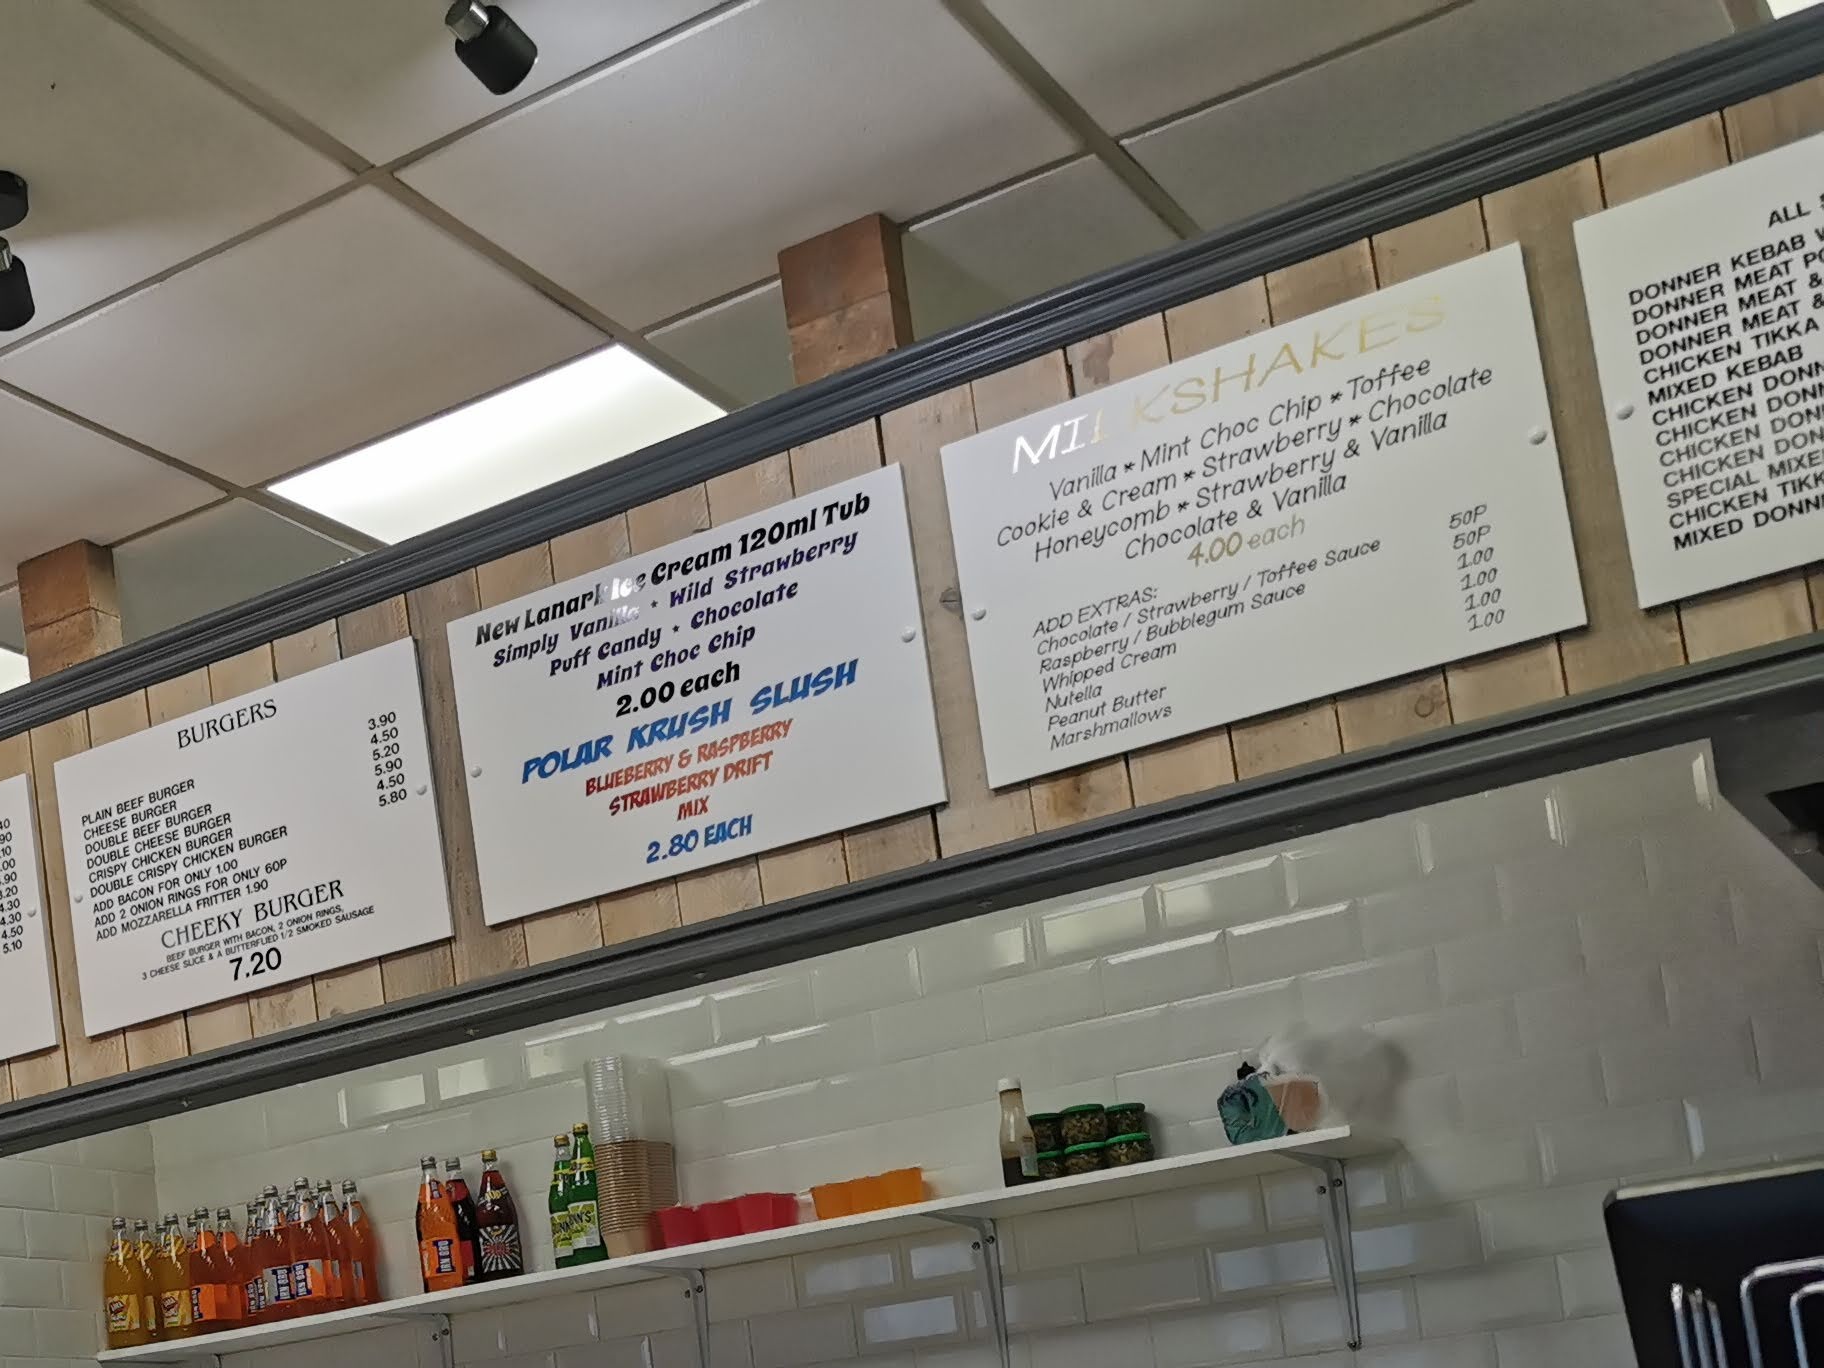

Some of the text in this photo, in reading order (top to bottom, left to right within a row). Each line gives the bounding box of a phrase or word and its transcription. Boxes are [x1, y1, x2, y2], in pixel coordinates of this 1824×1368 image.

[1768, 202, 1811, 228] ALL
[1628, 234, 1806, 306] DONNER KEBAB
[1632, 259, 1792, 326] DONNER MEAT
[1635, 272, 1823, 346] DONNER MEAT &
[1639, 292, 1824, 366] DONNER MEAT &
[1643, 317, 1820, 385] CHICKEN TIKKA
[1647, 344, 1804, 406] MIXED KEBAB
[997, 367, 1493, 547] Cookie & Cream Strawberry Chocolate
[1049, 359, 1431, 501] Vanilla Mint Choc Chip Toffee
[1035, 411, 1448, 563] Honeycomb Strawberry & Vanilla
[1125, 473, 1347, 560] Chocolate & Vanilla
[1186, 514, 1305, 568] 4.00 each
[1448, 504, 1487, 530] 50P
[475, 616, 521, 647] New
[650, 542, 732, 586] Cream
[738, 508, 818, 556] 120ml
[822, 492, 870, 527] Tub
[1457, 546, 1495, 570] 1.00
[492, 531, 858, 668] Simply Vanilla Wild Strawberry
[1032, 586, 1158, 638] ADD EXTRAS:
[1037, 620, 1119, 656] Chocolate
[1137, 583, 1239, 625] Strawberry
[1257, 558, 1318, 587] Toffee
[1324, 539, 1381, 567] Sauce
[549, 582, 799, 677] Puff Candy Chocolate
[596, 624, 756, 691] Mint Choc Chip
[615, 660, 740, 718] 2.00 each
[1042, 642, 1177, 694] Whipped Cream
[177, 699, 277, 749] BURGERS
[367, 711, 397, 731] 3.90
[521, 658, 859, 785] POLAR KRUSH SLUSH
[1045, 684, 1103, 713] Nutella
[1047, 686, 1167, 732] Peanut Butter
[370, 726, 399, 745] 4.50
[1050, 705, 1173, 751] Marshmallows
[585, 718, 794, 797] BLUEBERRY & RASPBERRY
[608, 750, 774, 817] STRAWBERRY DRIFT
[81, 778, 195, 827] PLAIN BEEF BURGER
[83, 799, 177, 841] CHEESE BURGER
[676, 795, 710, 822] MIX
[88, 827, 233, 884] CRISPY CHICKEN BURGER
[646, 813, 753, 865] 2.80 EACH
[93, 858, 238, 914] ADD BACON FOR ONLY 1.00
[161, 879, 344, 949] CHEEKY BURGER
[166, 950, 186, 963] BEEF
[188, 940, 221, 957] BURGER
[222, 933, 243, 946] WITH
[286, 913, 313, 928] ONION
[229, 946, 282, 981] 7.20
